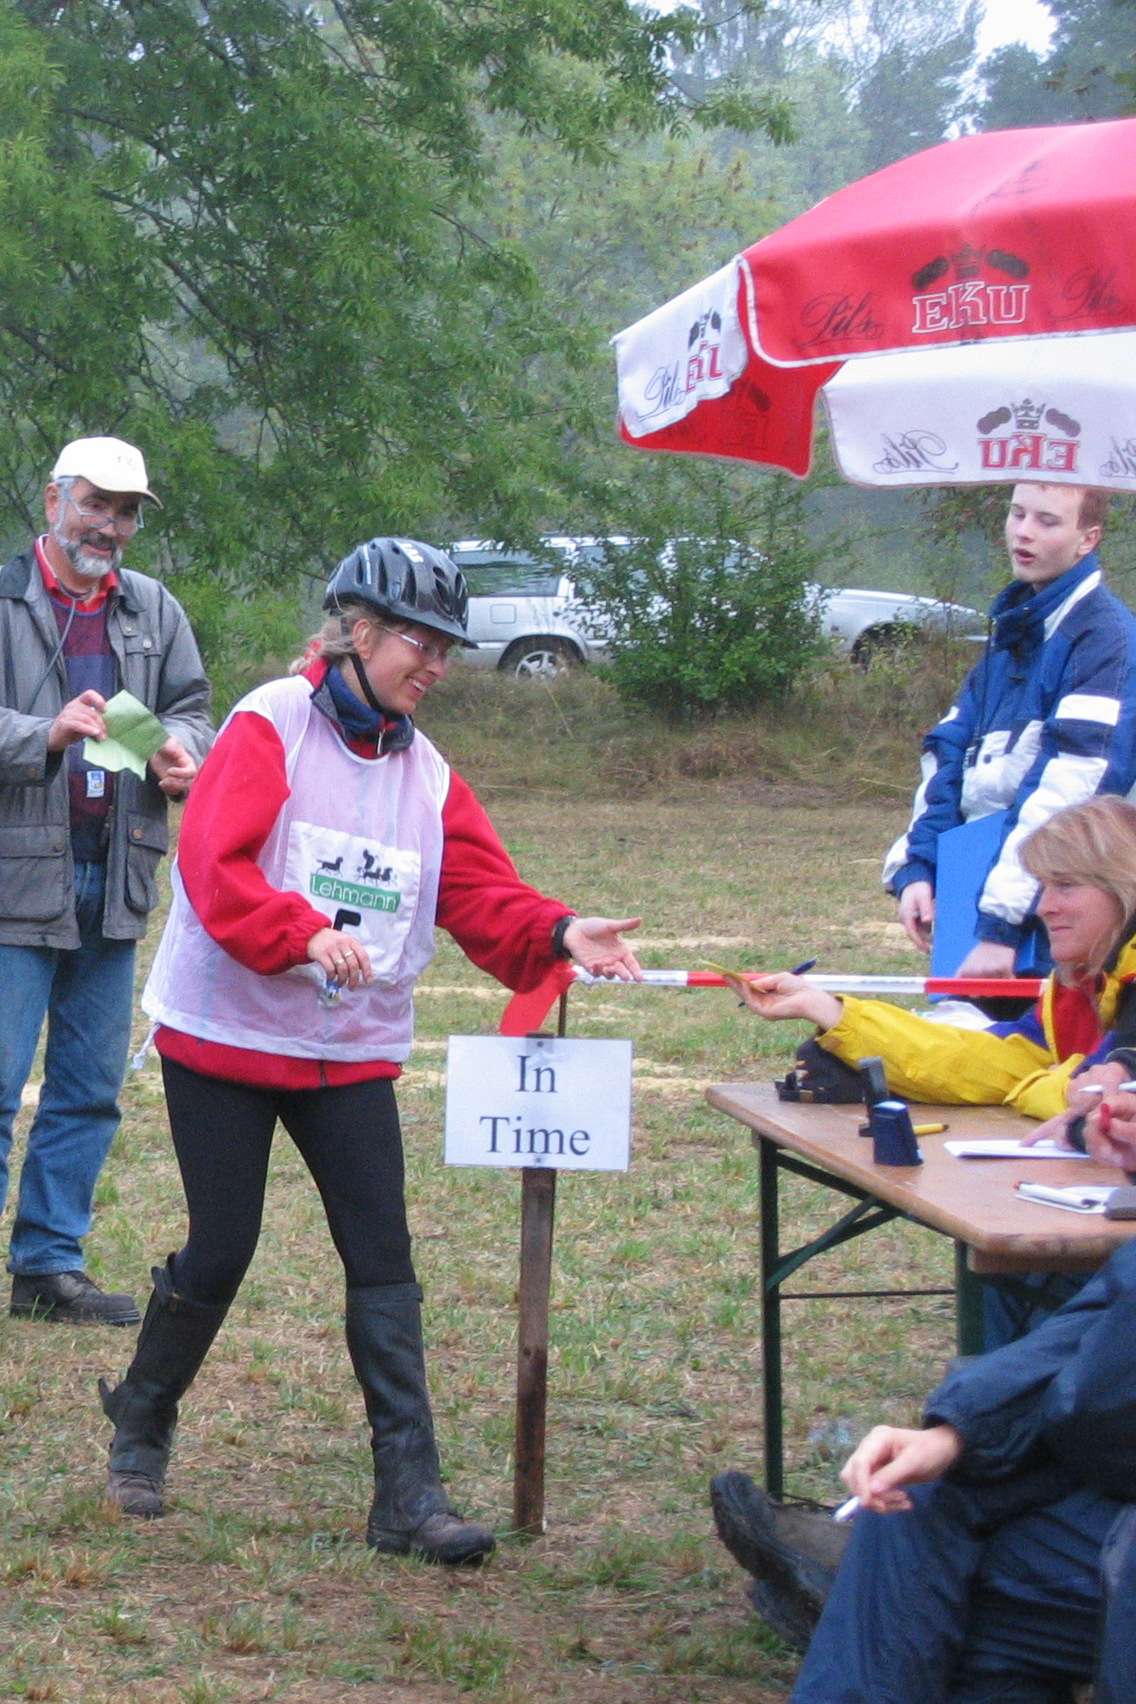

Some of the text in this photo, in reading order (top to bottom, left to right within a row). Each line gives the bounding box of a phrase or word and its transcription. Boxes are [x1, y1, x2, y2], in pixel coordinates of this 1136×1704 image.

[912, 280, 1030, 333] EKU
[310, 874, 398, 912] Lehmann
[515, 1055, 558, 1093] In
[479, 1115, 591, 1156] Time
